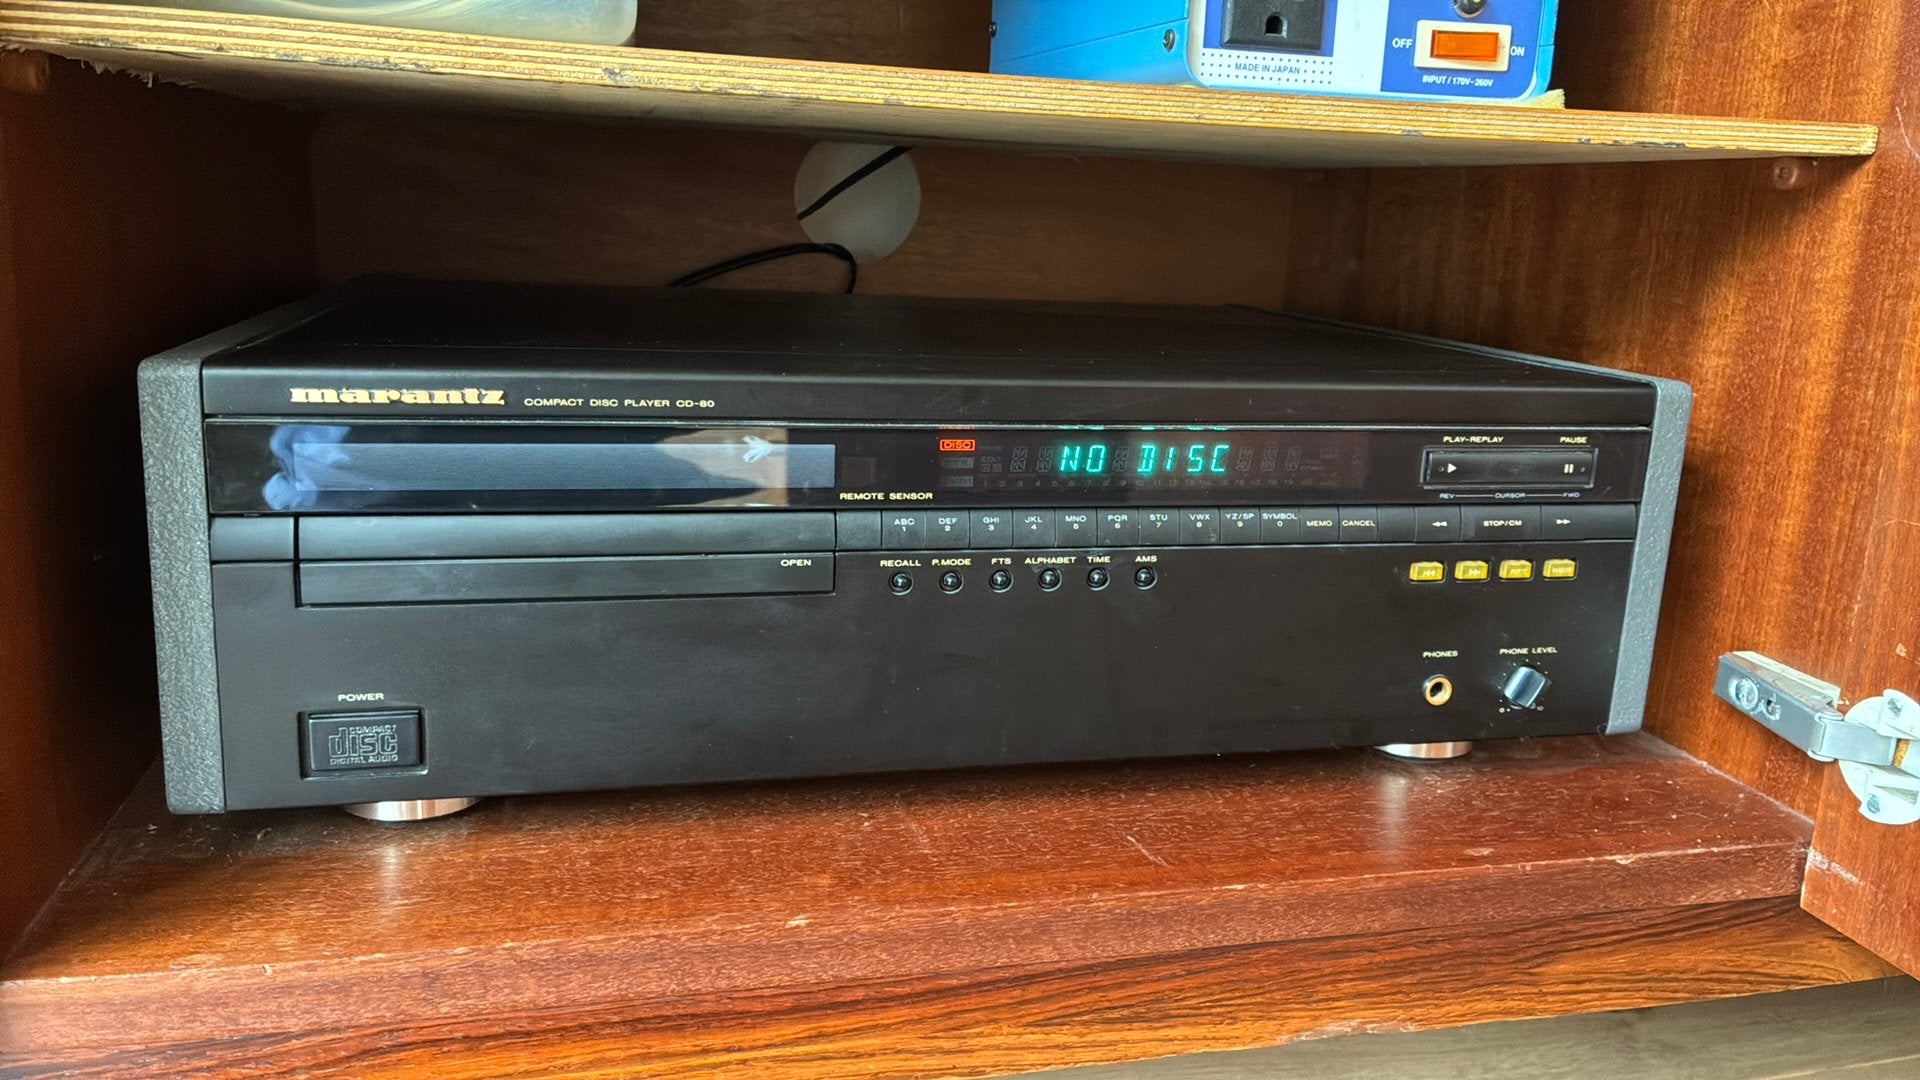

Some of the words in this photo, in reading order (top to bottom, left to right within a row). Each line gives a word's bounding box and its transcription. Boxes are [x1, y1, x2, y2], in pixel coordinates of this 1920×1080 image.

[1392, 37, 1414, 49] OFF
[1510, 46, 1525, 56] ON
[1234, 62, 1259, 72] MADE
[1272, 66, 1300, 74] JAPAN
[1422, 75, 1446, 84] INPUT
[290, 388, 505, 406] marantz
[524, 398, 584, 406] COMPACT
[590, 399, 618, 407] DISC
[624, 400, 670, 408] PLAYER
[676, 400, 715, 408] CD-80
[944, 440, 972, 449] DISC
[1060, 445, 1105, 472] NO
[1138, 445, 1230, 472] DISC
[894, 518, 915, 526] ABC
[1484, 520, 1522, 528] STOP/CM
[988, 524, 995, 532] 3
[1024, 556, 1076, 564] ALPHABET
[1087, 556, 1110, 564] TIME
[338, 693, 384, 702] POWER
[349, 724, 397, 734] COMPACT
[330, 758, 366, 766] DIGITAL
[368, 754, 398, 763] AUDIO
